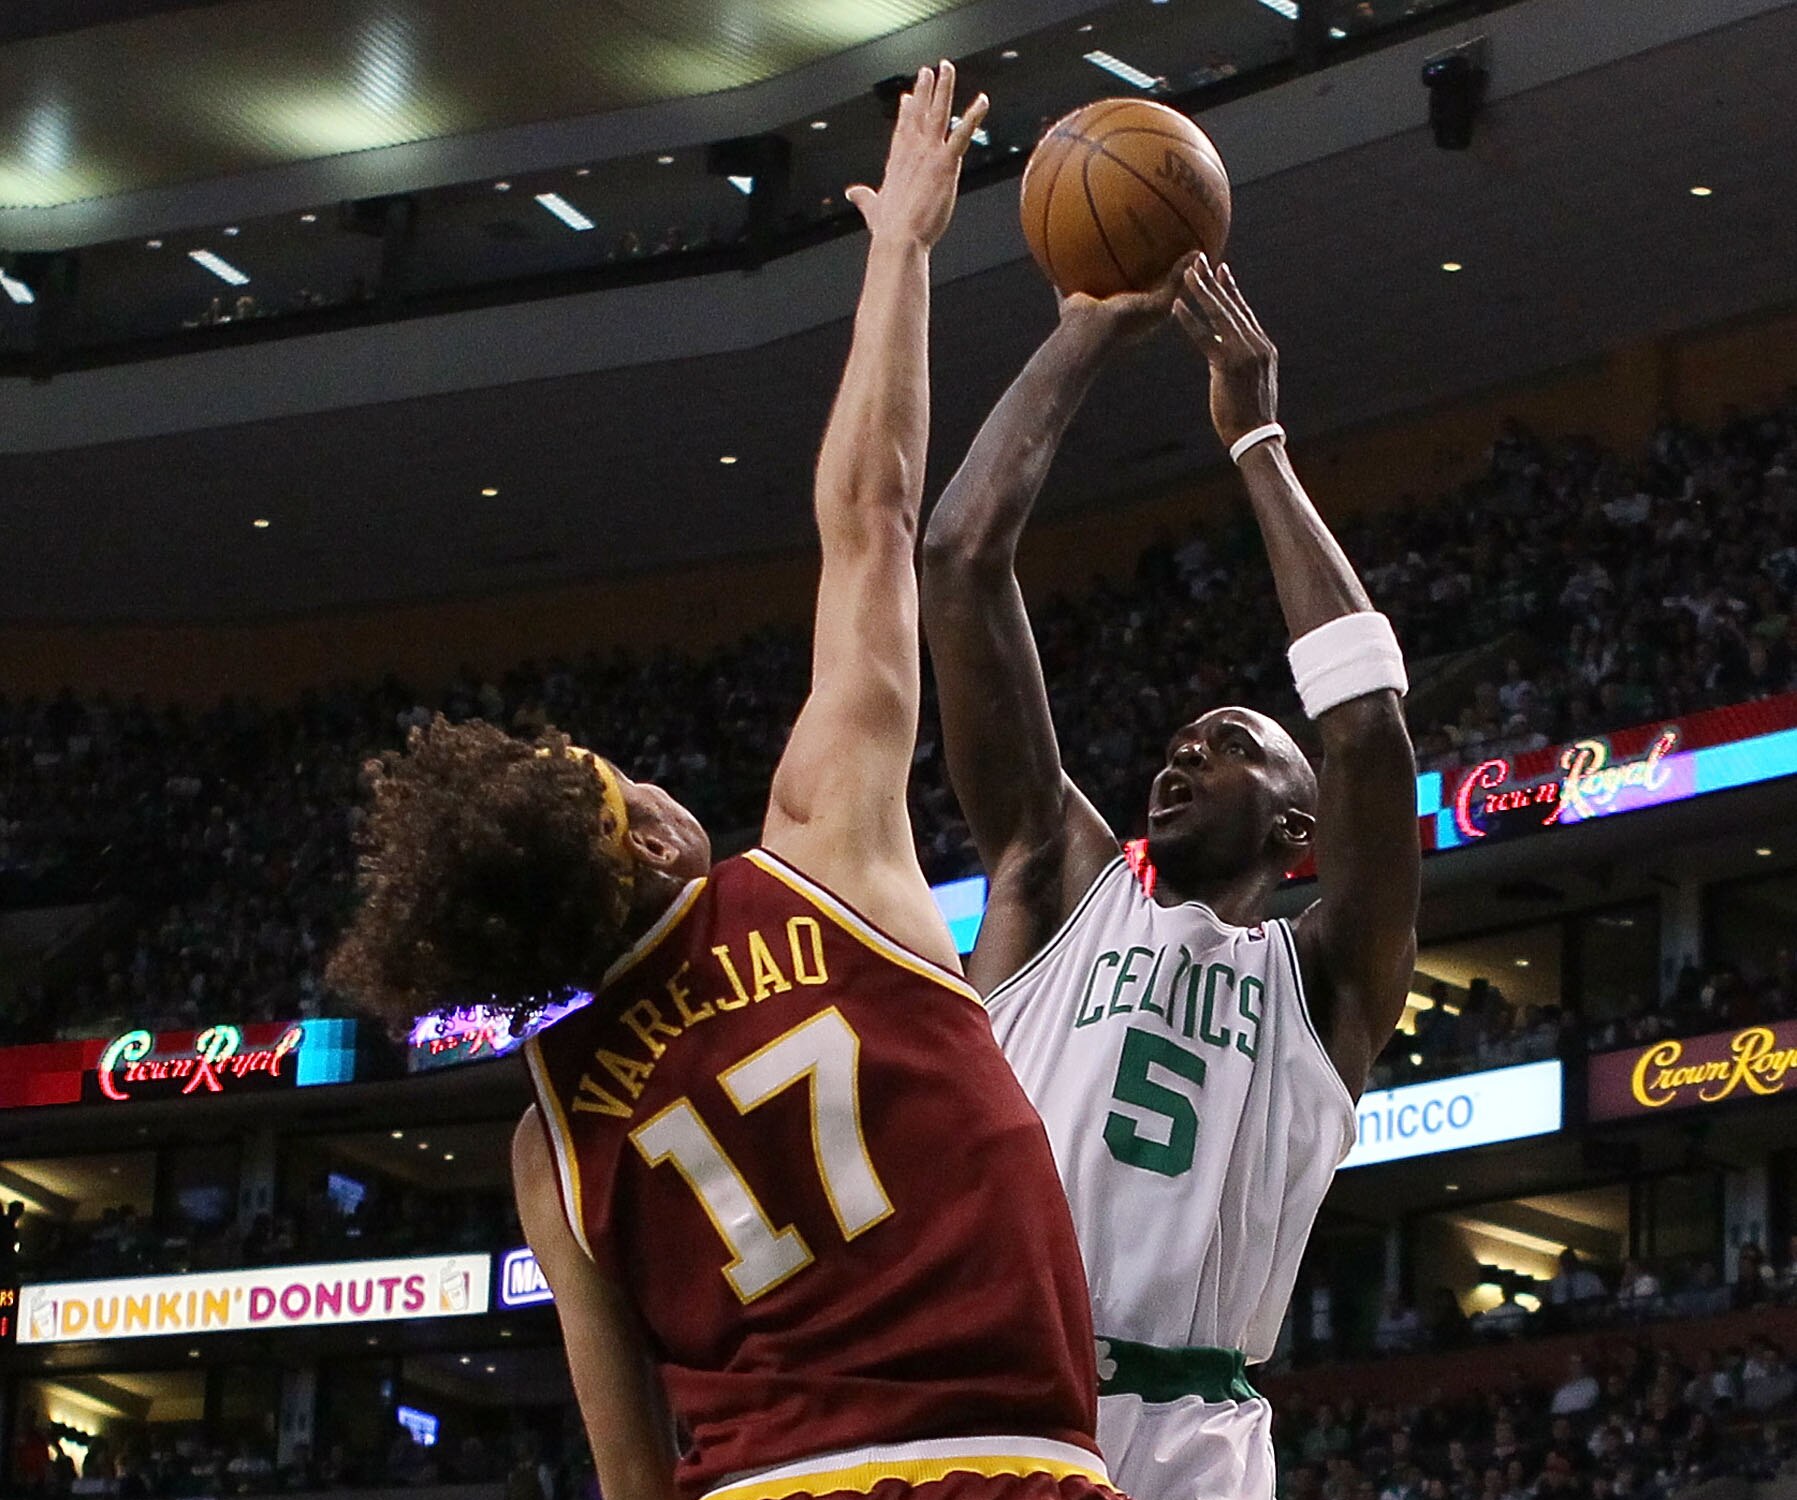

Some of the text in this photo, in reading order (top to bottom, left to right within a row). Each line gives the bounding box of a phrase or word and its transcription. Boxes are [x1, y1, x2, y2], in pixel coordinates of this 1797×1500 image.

[1456, 735, 1677, 837] Crown Royal
[571, 916, 829, 1119] VAREJAO
[1074, 944, 1266, 1063] CELTICS
[99, 1024, 303, 1101] Crown Royal
[1102, 1026, 1207, 1178] 5
[1632, 1039, 1730, 1107] Crown
[627, 1004, 895, 1305] 17
[1358, 1093, 1474, 1145] nicco
[61, 1264, 426, 1336] DUNKIN' DONUTS
